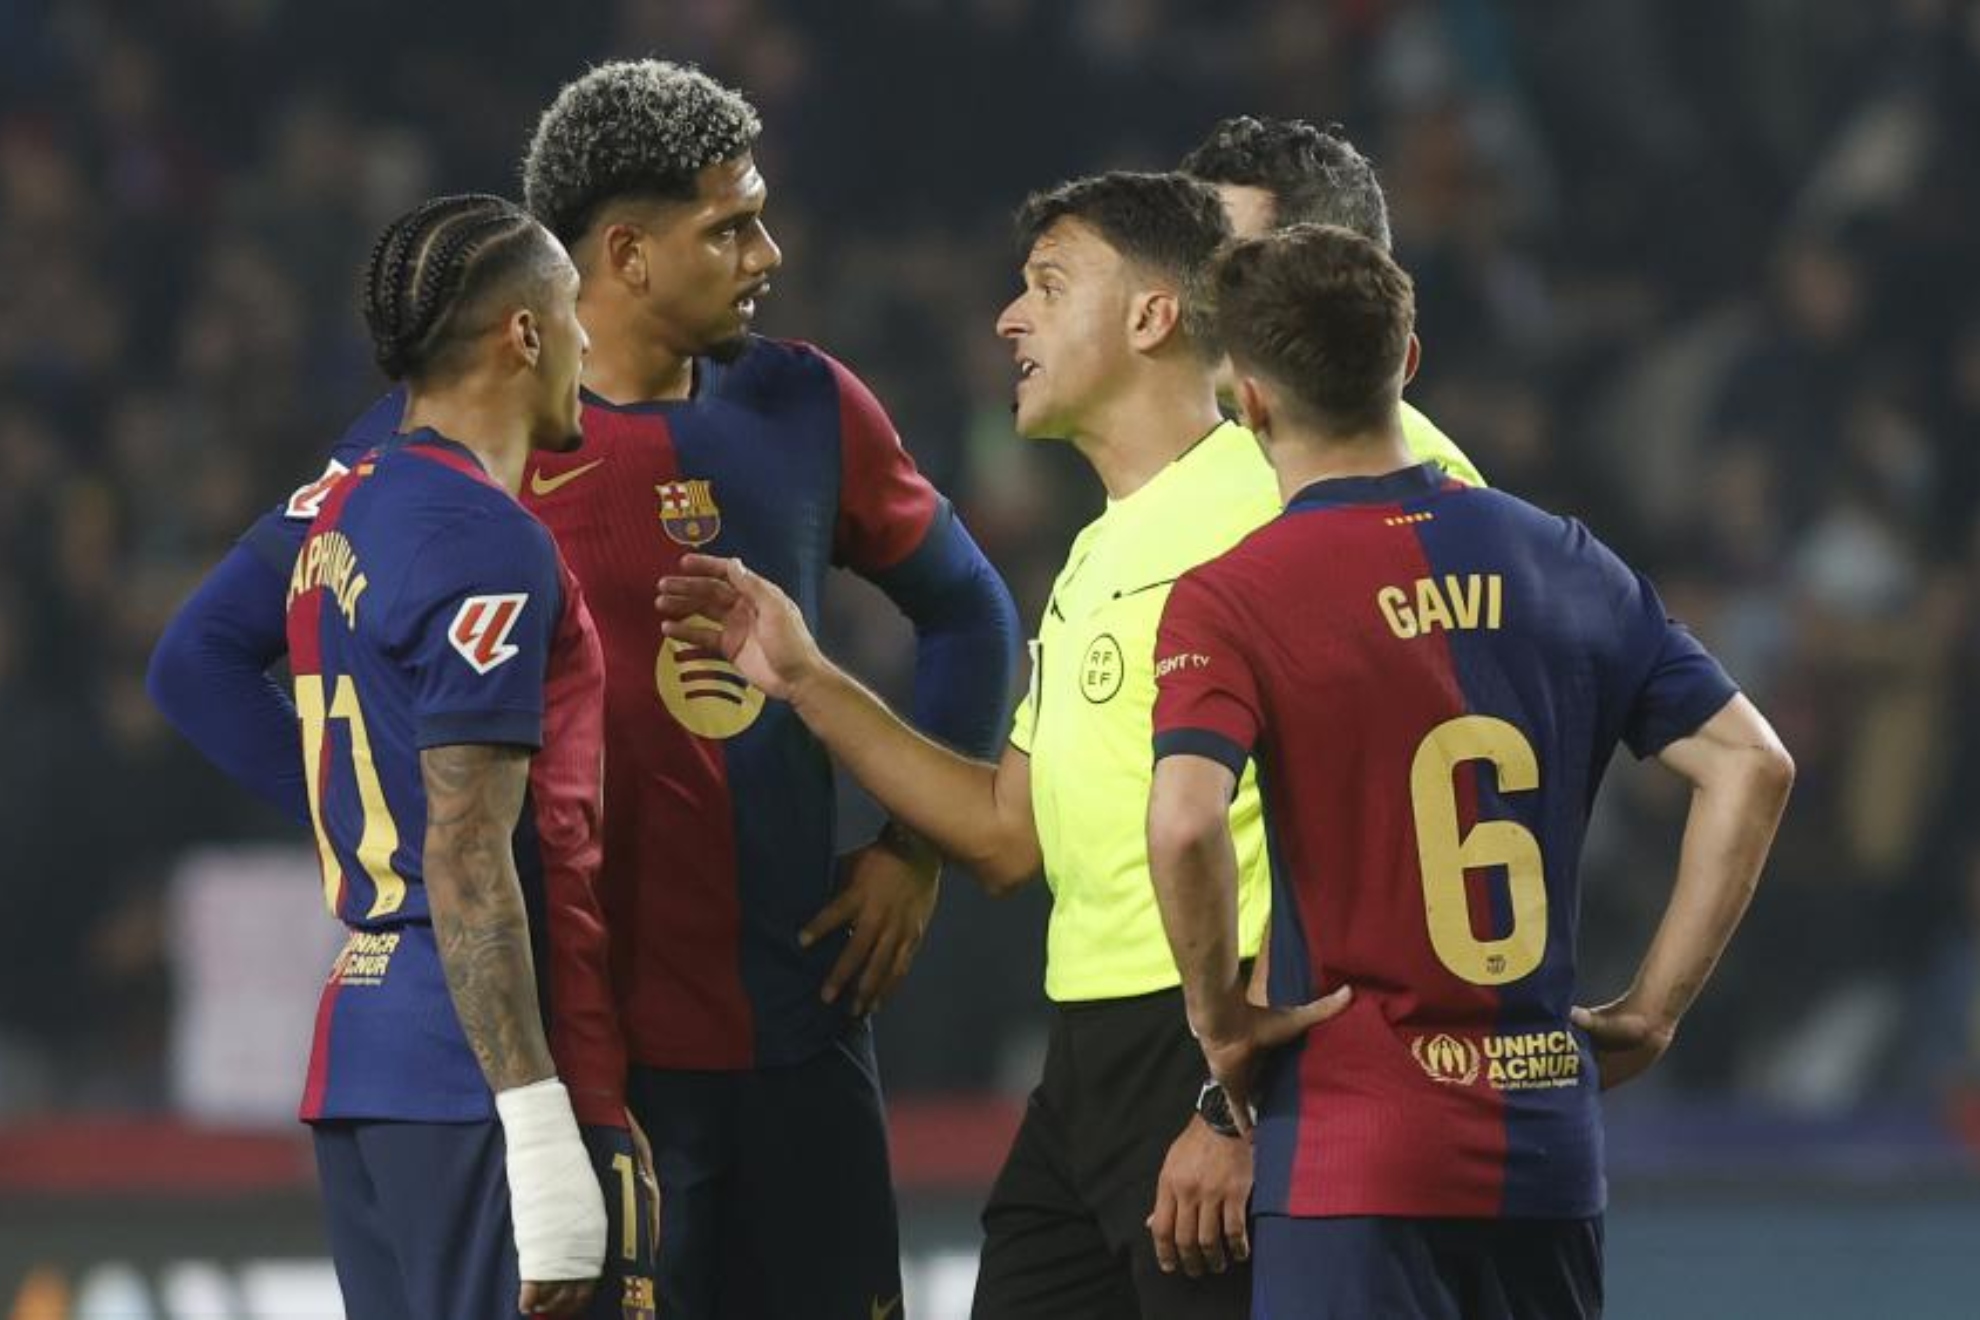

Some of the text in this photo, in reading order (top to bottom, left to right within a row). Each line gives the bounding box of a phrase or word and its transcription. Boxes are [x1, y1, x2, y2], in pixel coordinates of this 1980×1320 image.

[1378, 573, 1502, 639] GAVI
[1410, 714, 1548, 986] 6
[1487, 1054, 1580, 1080] ACNUR
